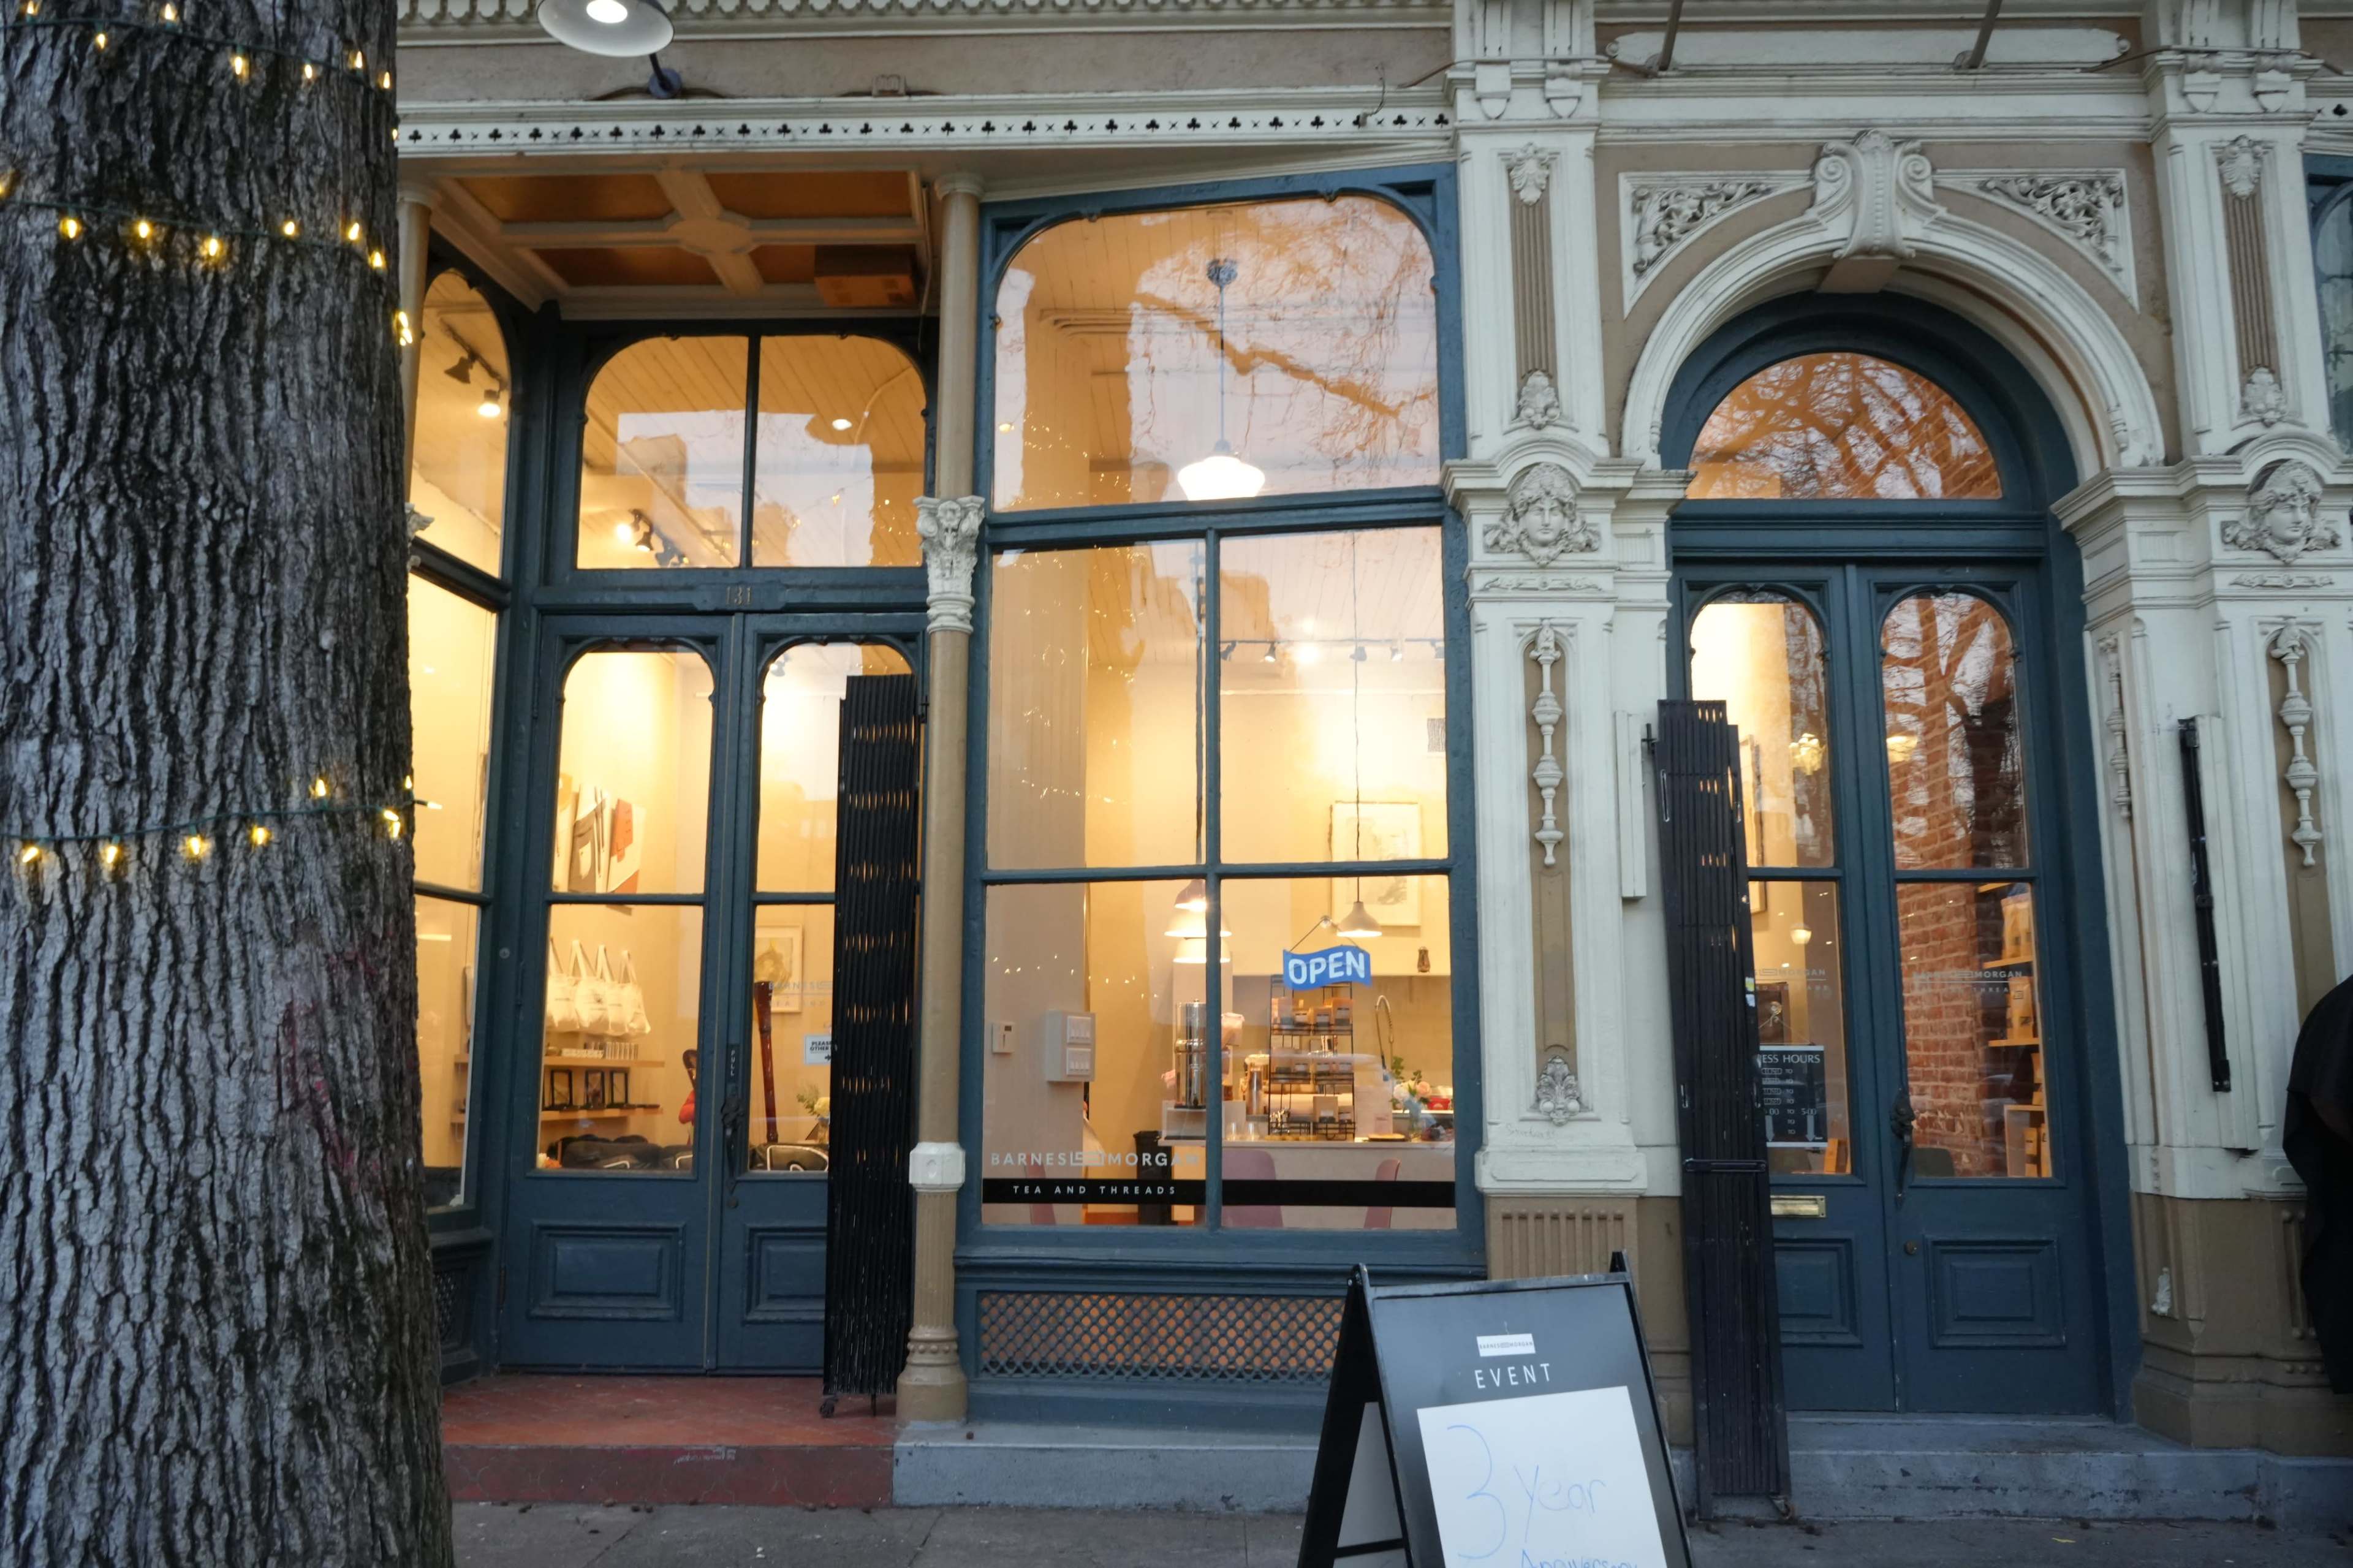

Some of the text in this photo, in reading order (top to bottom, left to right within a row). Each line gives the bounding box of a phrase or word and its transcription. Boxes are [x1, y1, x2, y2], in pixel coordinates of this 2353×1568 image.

[726, 586, 752, 605] 131
[1289, 951, 1365, 984] OPEN
[1783, 1055, 1821, 1063] HOURS
[991, 1152, 1200, 1167] BARNES MORGAN
[1014, 1186, 1175, 1195] TEA AND THREADS
[1474, 1363, 1550, 1388] EVENT
[1447, 1425, 1606, 1559] 3 Year
